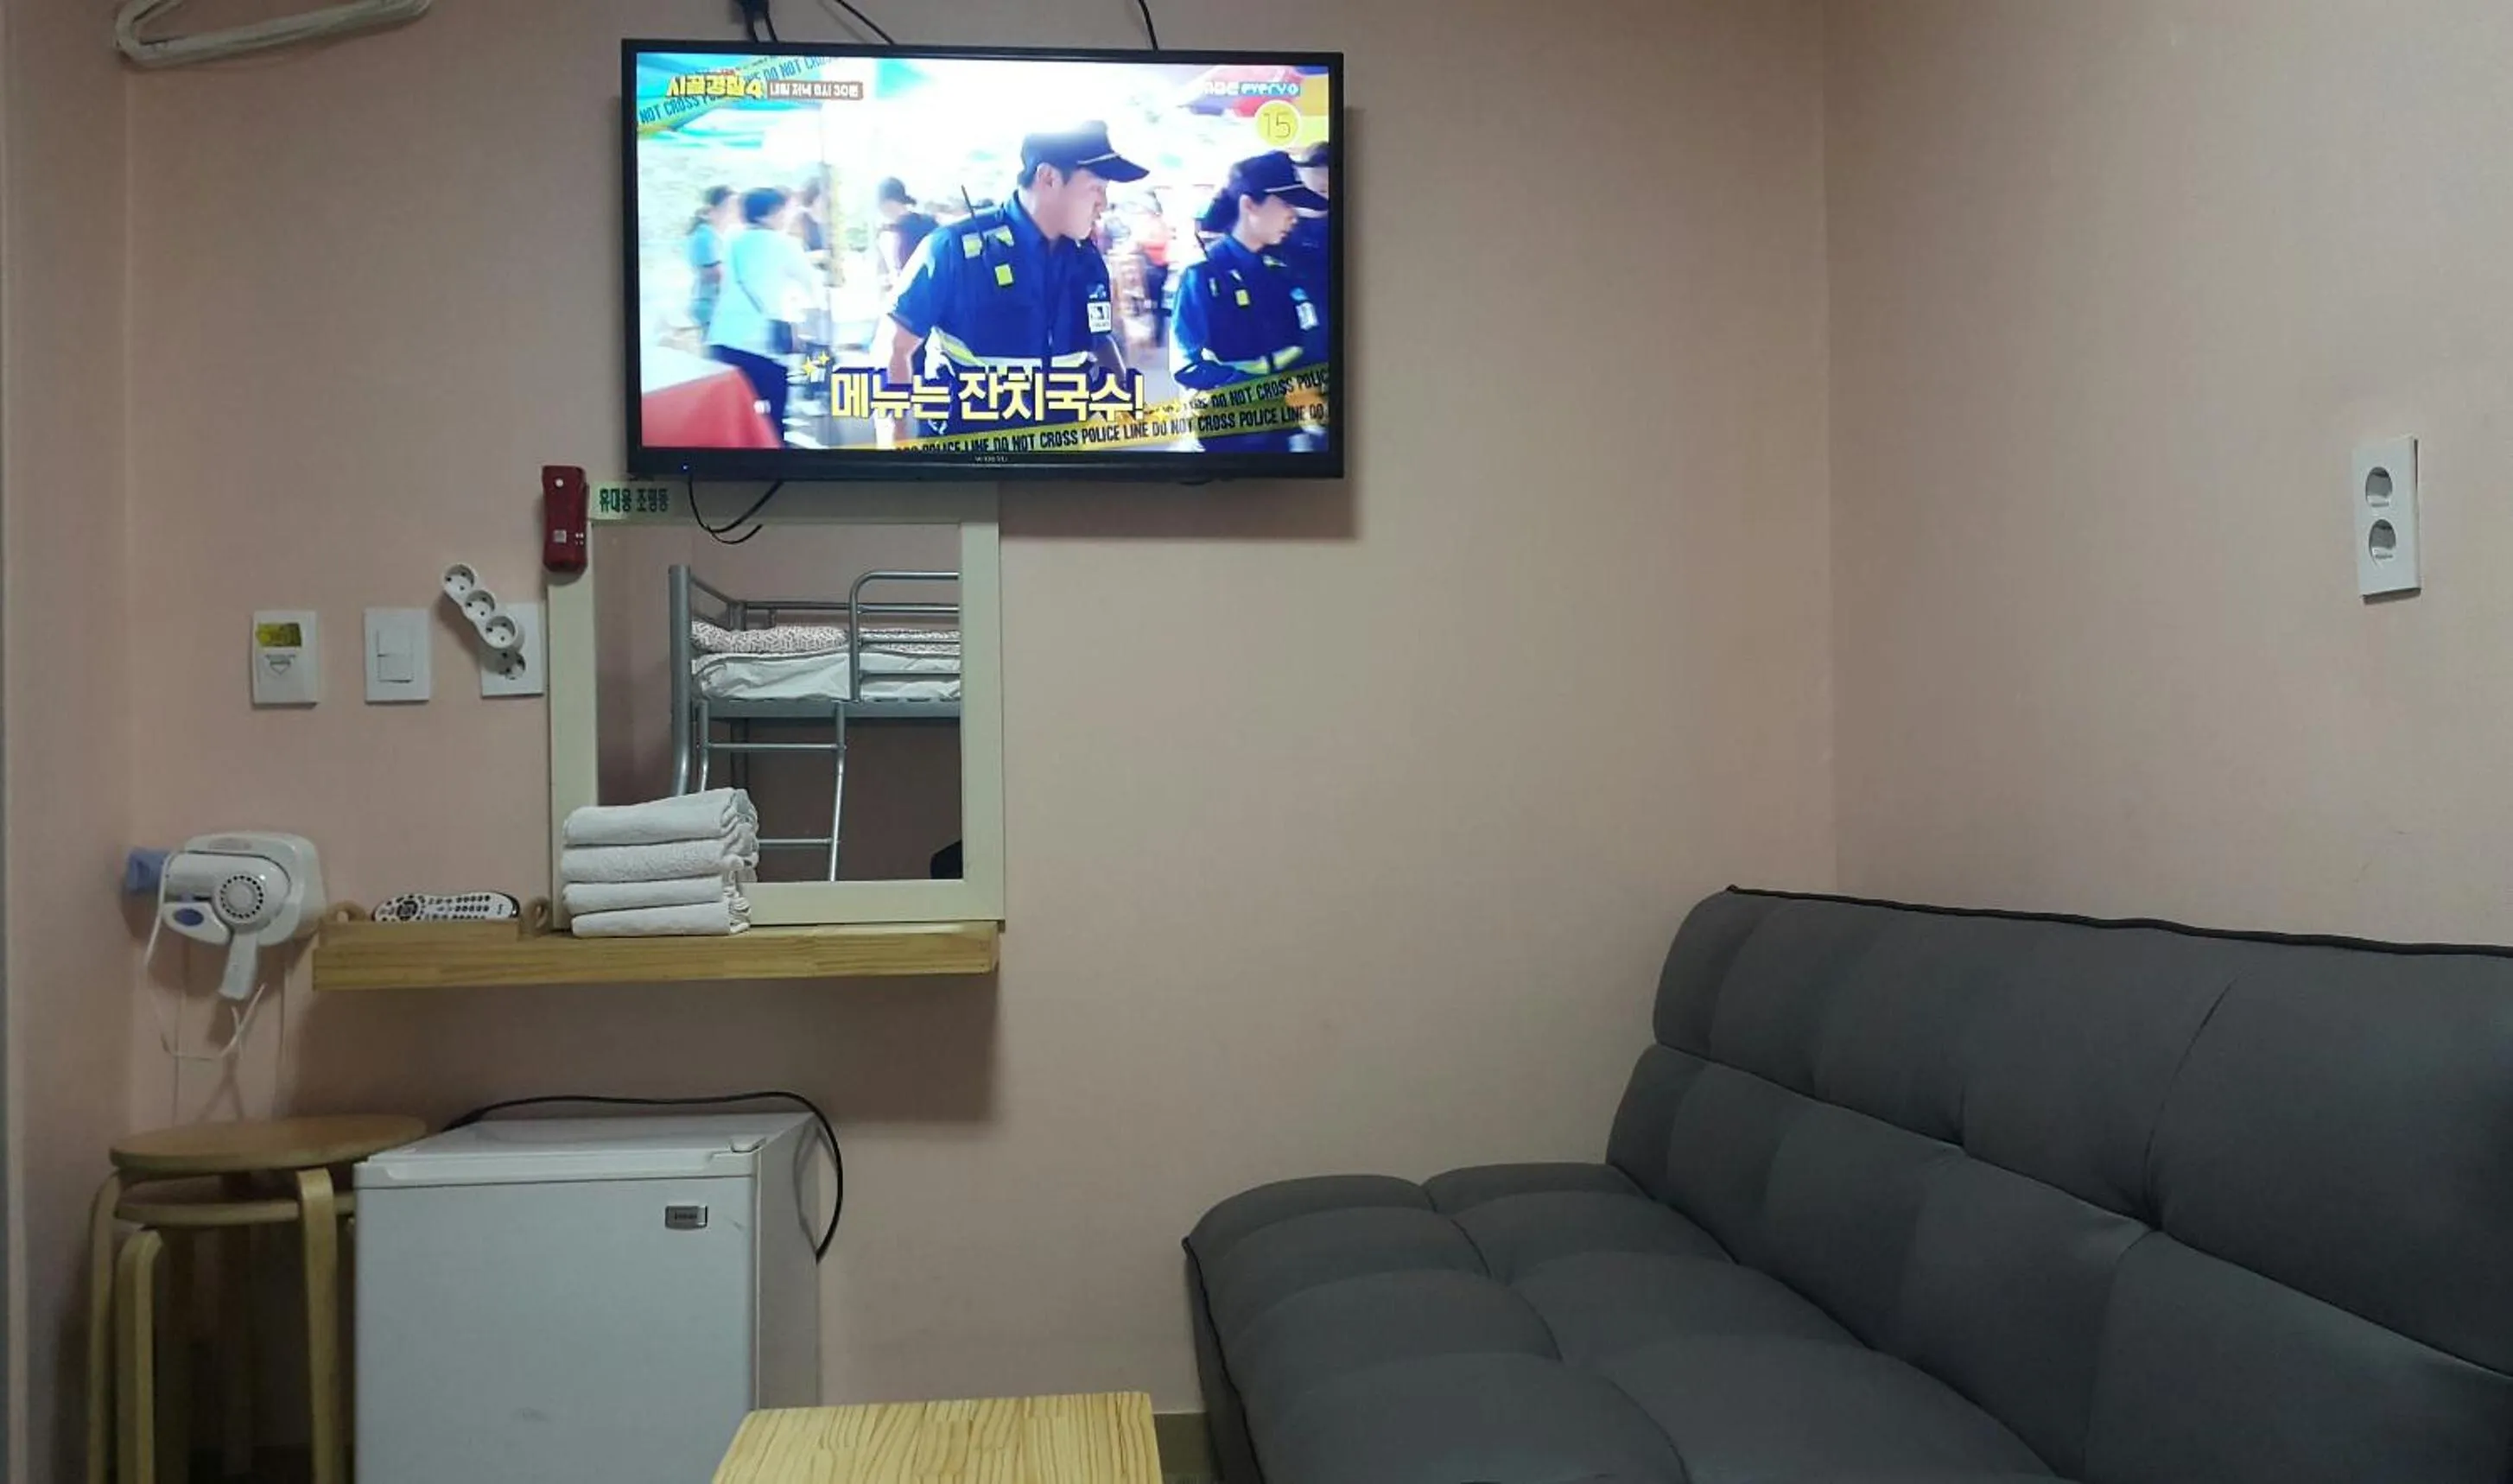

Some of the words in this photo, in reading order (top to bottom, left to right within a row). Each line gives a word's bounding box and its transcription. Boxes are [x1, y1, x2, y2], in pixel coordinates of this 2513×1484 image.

[638, 104, 662, 124] NOT
[663, 96, 701, 116] CROSS
[1262, 111, 1291, 138] 15
[830, 371, 952, 421] 메뉴는
[958, 371, 1145, 422] 잔치국수!
[1229, 388, 1253, 406] NOT
[1257, 377, 1295, 399] CROSS
[1298, 369, 1329, 389] POLIC
[993, 436, 1009, 453] DO
[1012, 433, 1036, 452] NOT
[1039, 429, 1079, 447] CROSS
[1082, 424, 1120, 443] POLICE
[1124, 424, 1150, 440] LINE
[1152, 422, 1167, 436] DO
[1171, 419, 1194, 434] NOT
[1197, 415, 1235, 432] CROSS
[1240, 409, 1278, 428] POLICE
[1281, 407, 1306, 423] LINE
